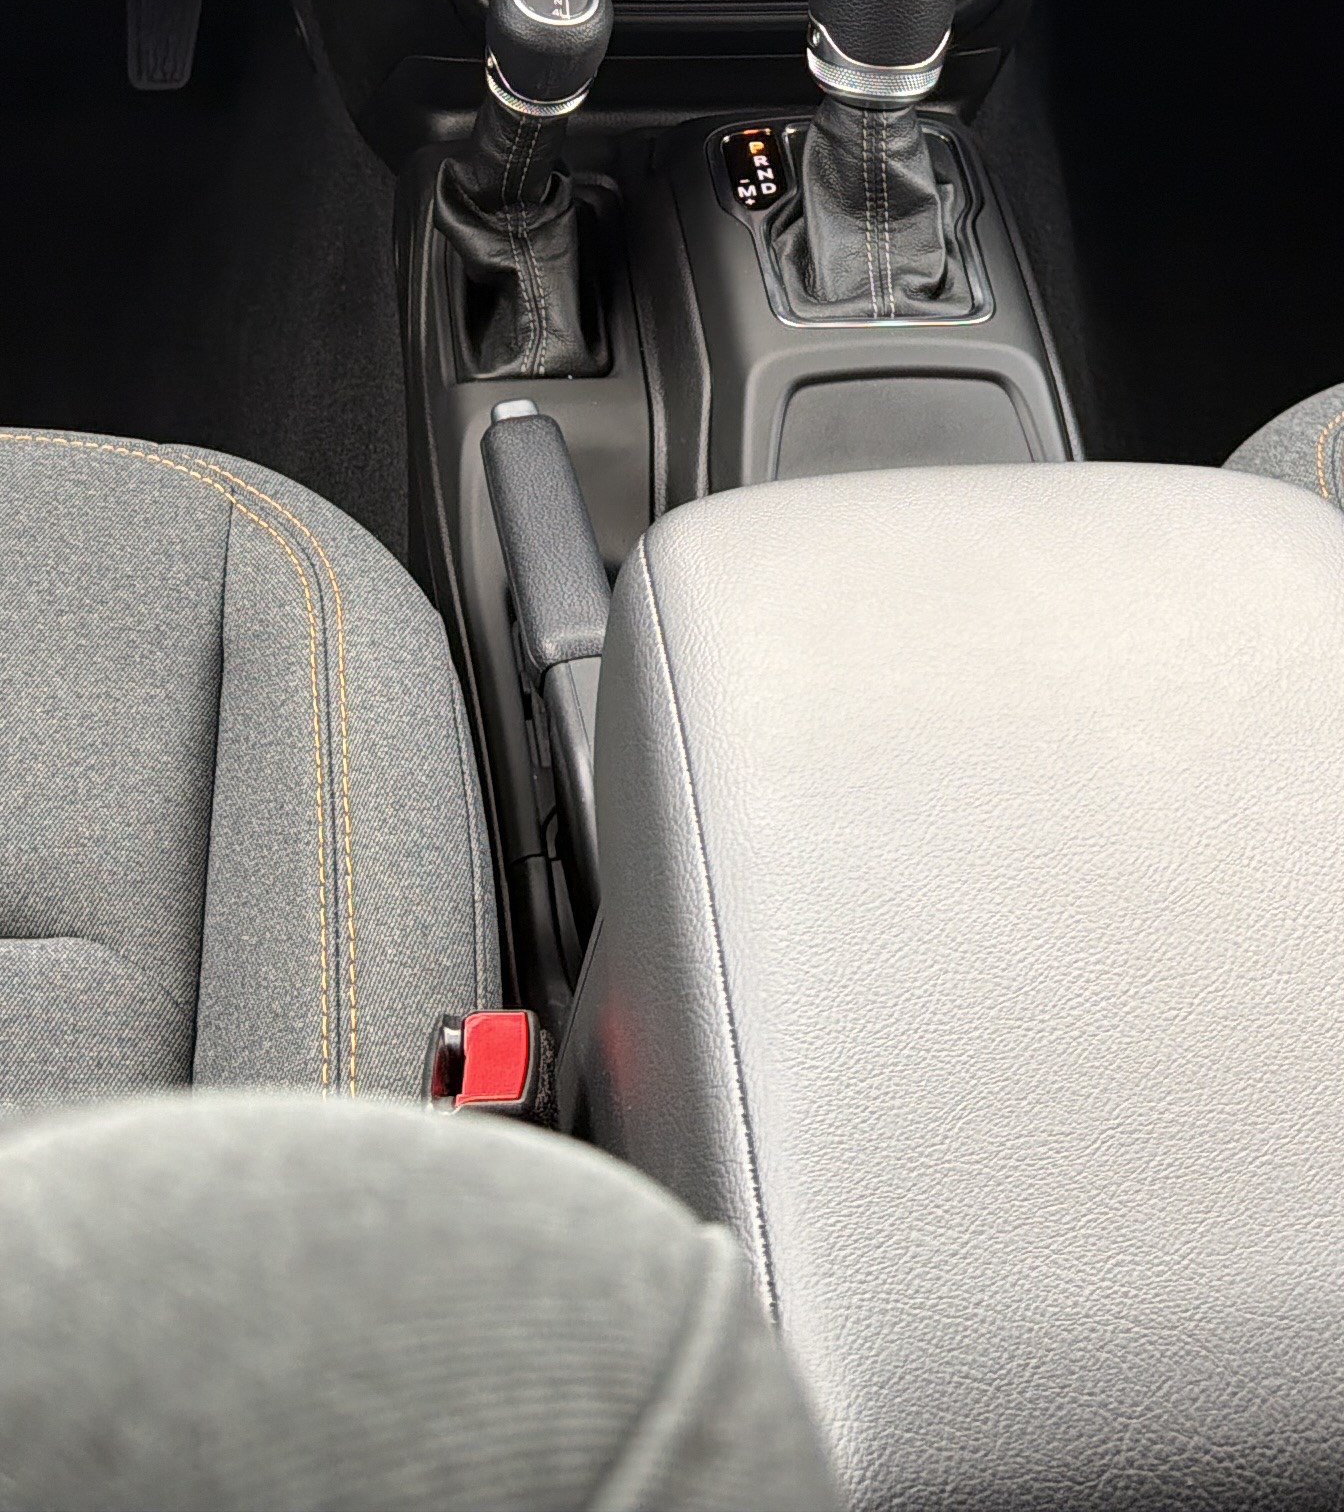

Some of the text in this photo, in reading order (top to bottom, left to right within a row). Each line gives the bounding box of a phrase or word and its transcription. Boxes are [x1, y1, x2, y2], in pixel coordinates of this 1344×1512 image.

[749, 141, 765, 155] P
[753, 155, 770, 167] R
[757, 168, 774, 181] N
[737, 184, 758, 199] M
[760, 182, 777, 195] D
